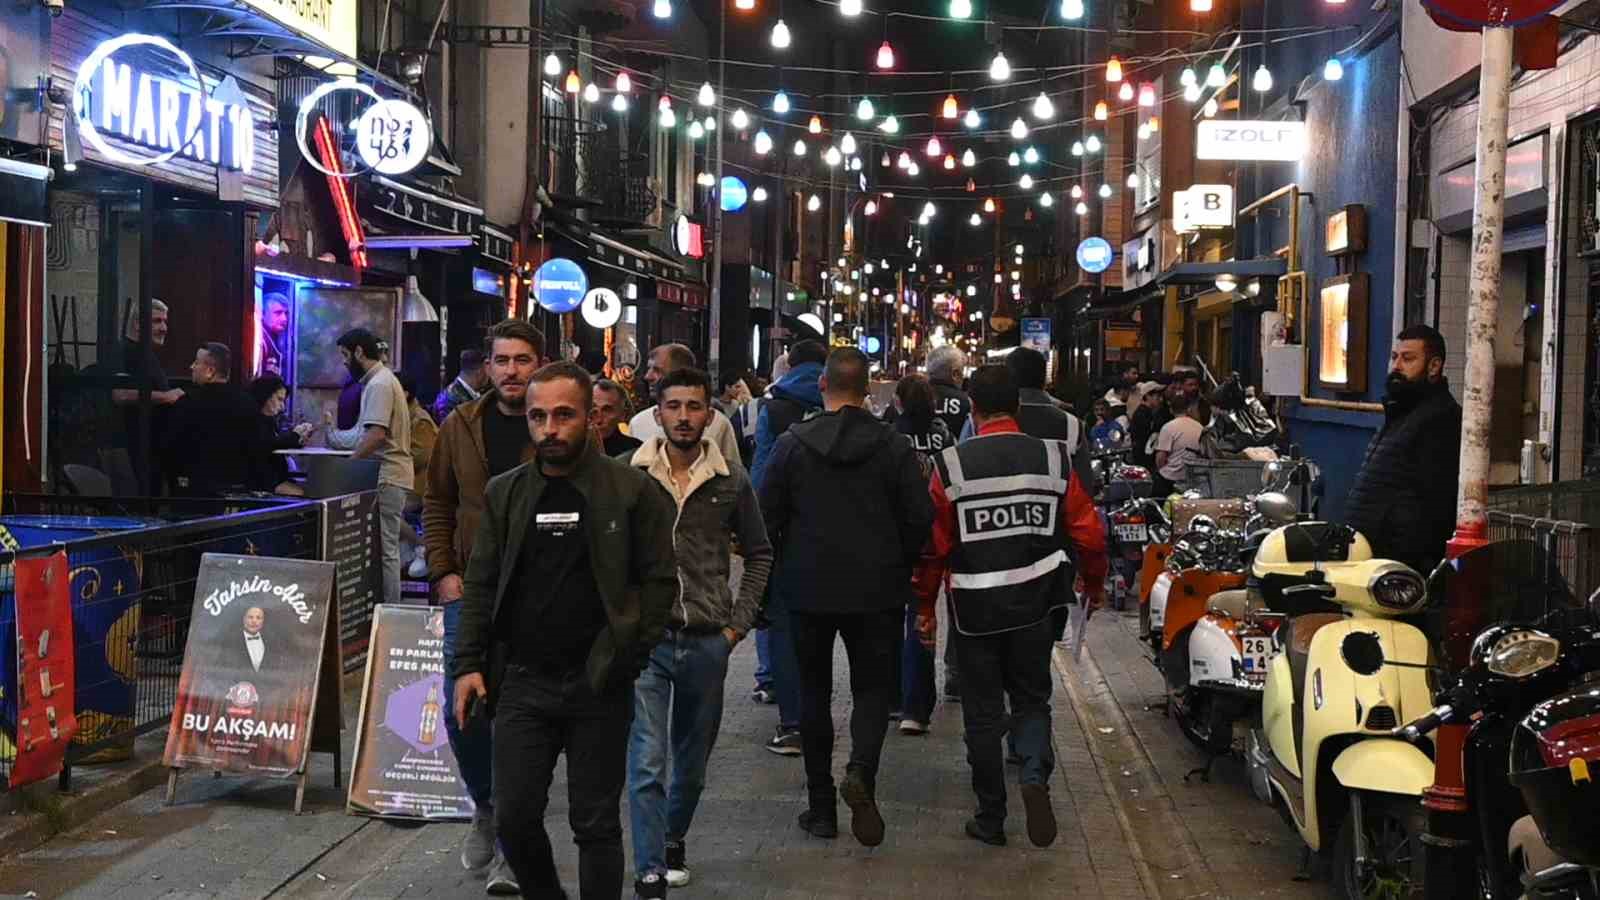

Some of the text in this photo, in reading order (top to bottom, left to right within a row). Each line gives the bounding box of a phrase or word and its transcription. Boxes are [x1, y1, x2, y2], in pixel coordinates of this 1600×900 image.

[935, 398, 961, 414] LiS
[906, 434, 943, 450] LiS
[204, 575, 272, 616] Tahsin
[389, 648, 403, 656] EN
[1245, 640, 1265, 653] 26
[421, 662, 445, 673] MAL
[182, 714, 297, 740] BU AKŞAM!
